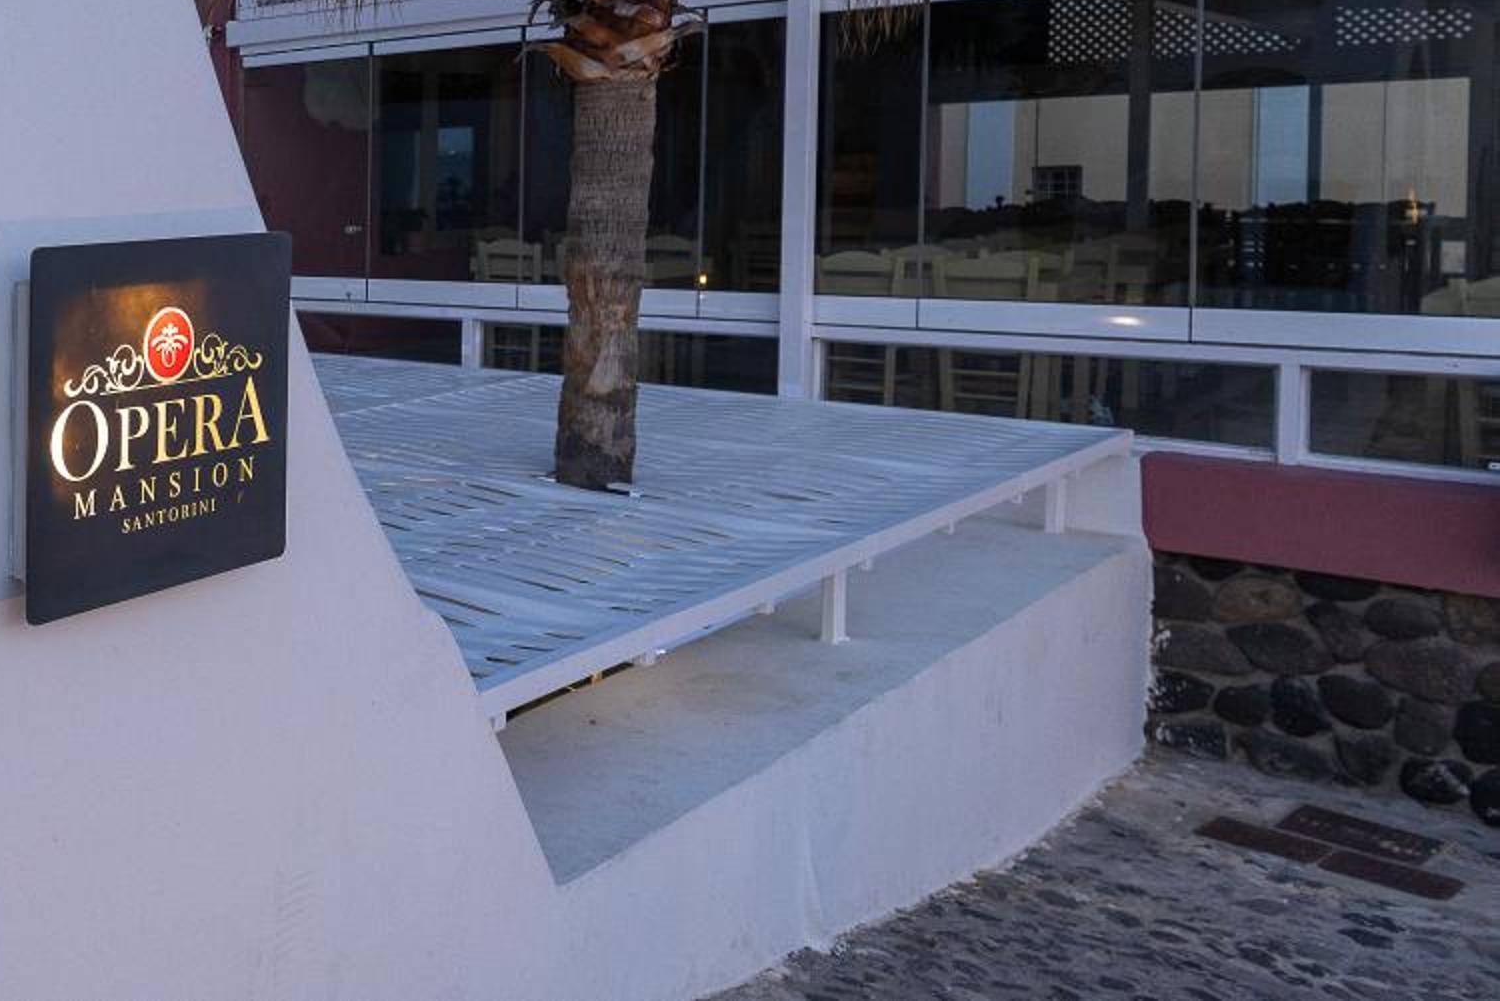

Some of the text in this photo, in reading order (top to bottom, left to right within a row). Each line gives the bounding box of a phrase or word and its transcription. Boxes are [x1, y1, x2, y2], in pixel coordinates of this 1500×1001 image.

[51, 376, 270, 482] OPERA
[73, 455, 254, 520] MANSION
[121, 498, 216, 534] SANTORINI
